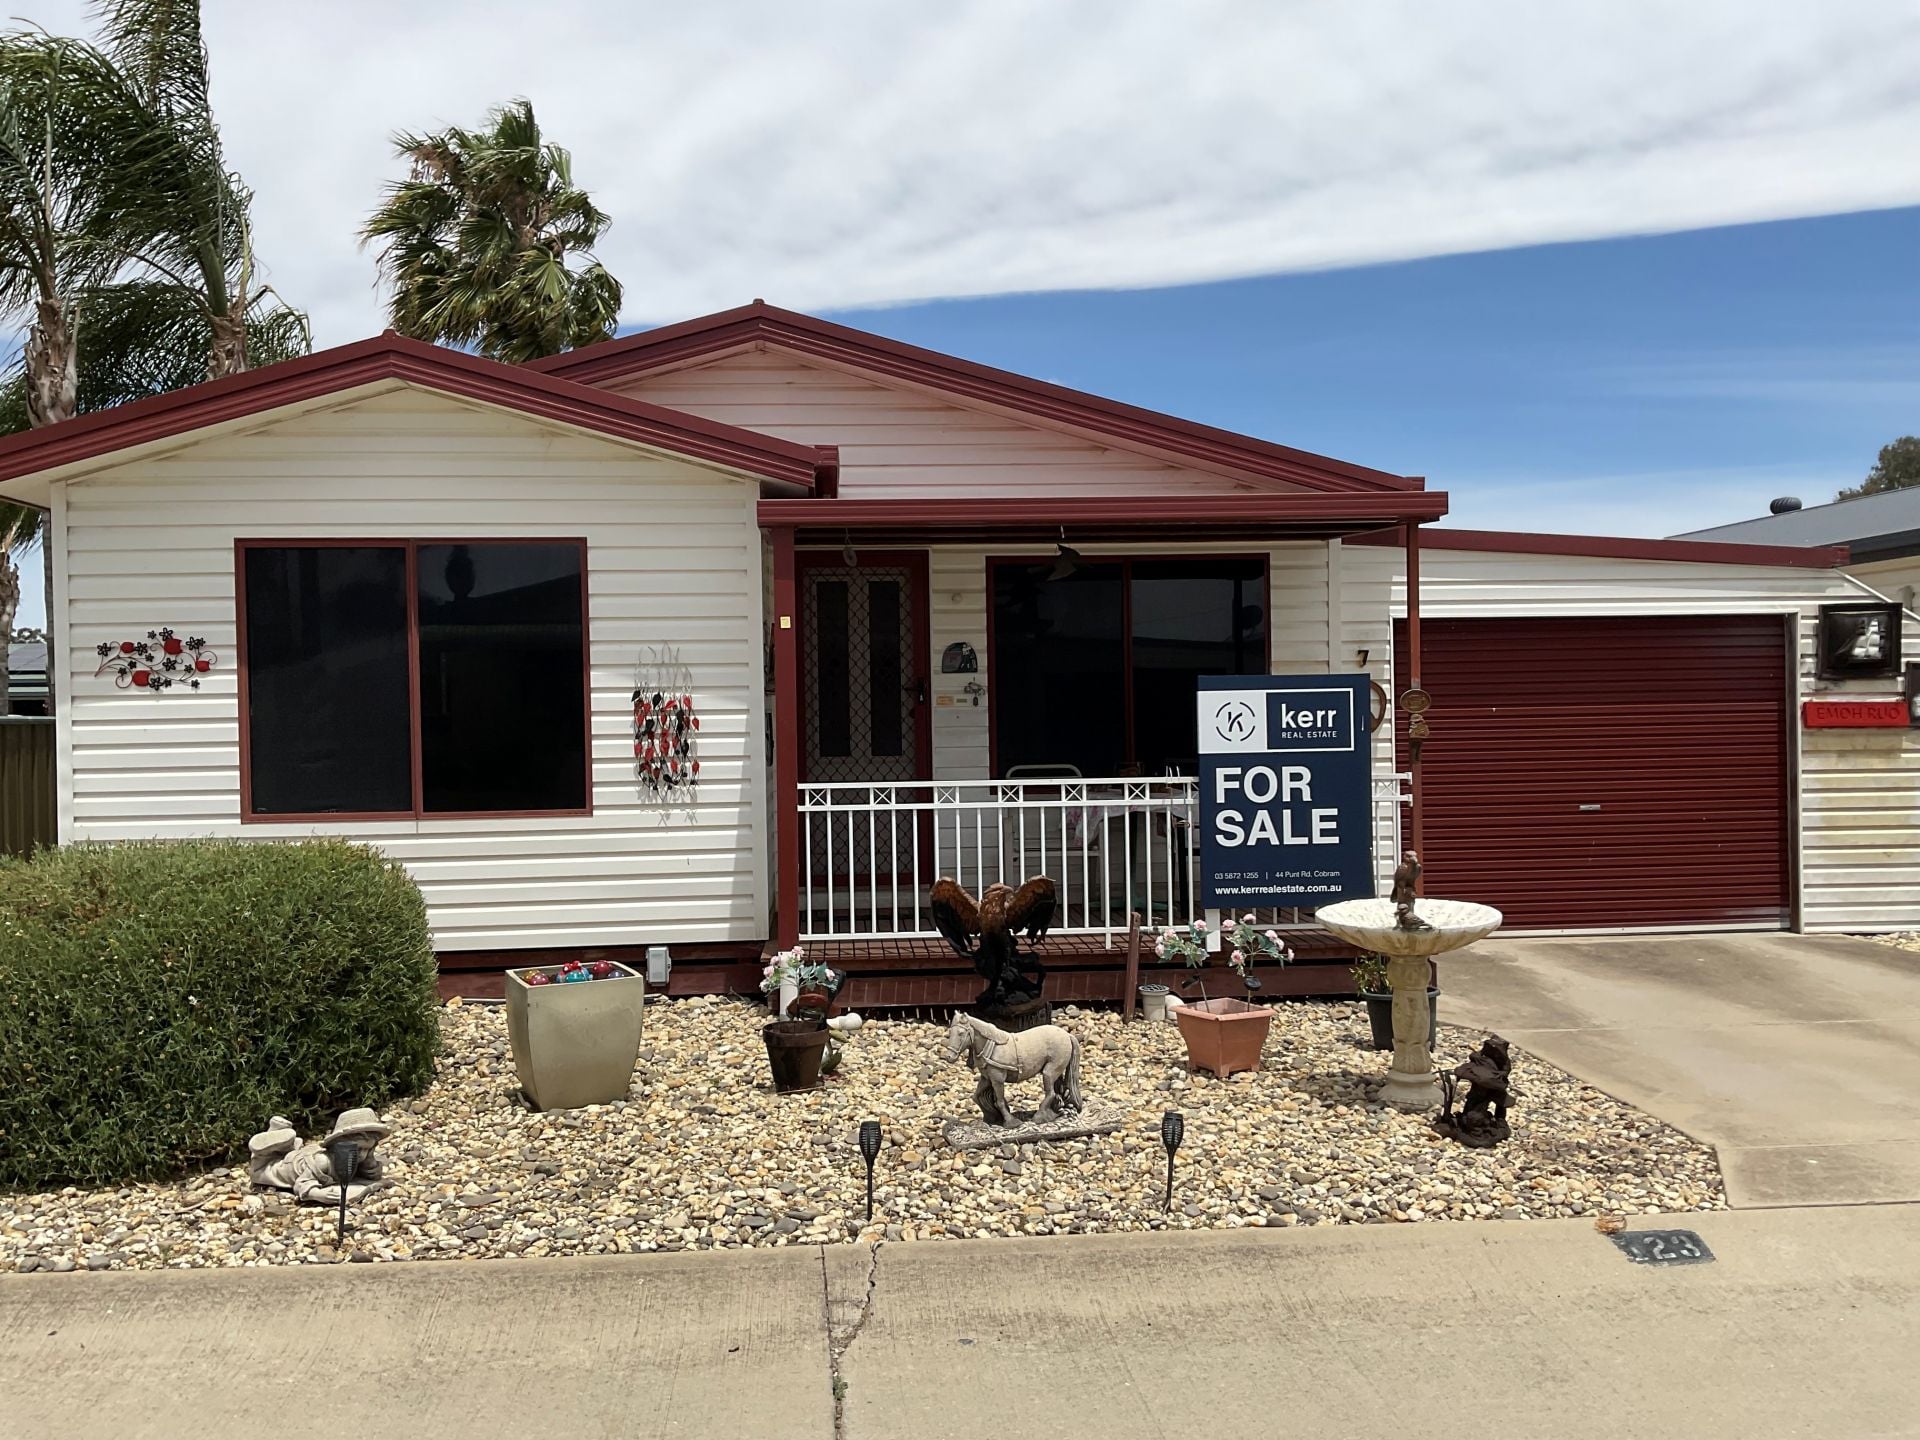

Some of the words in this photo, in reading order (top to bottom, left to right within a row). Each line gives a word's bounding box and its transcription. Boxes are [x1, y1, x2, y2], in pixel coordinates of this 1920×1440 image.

[1281, 703, 1337, 729] kerr
[1816, 707, 1863, 720] EMOH
[1281, 731, 1304, 739] REAL
[1307, 730, 1337, 738] ESTATE
[1215, 765, 1313, 804] FOR
[1215, 808, 1340, 847] SALE
[1214, 872, 1224, 880] 03
[1224, 872, 1242, 880] 5872
[1243, 871, 1259, 879] 1255
[1284, 870, 1300, 878] Punt
[1313, 869, 1341, 878] Cobram
[1215, 884, 1342, 895] www.kerrrealestate.com.au
